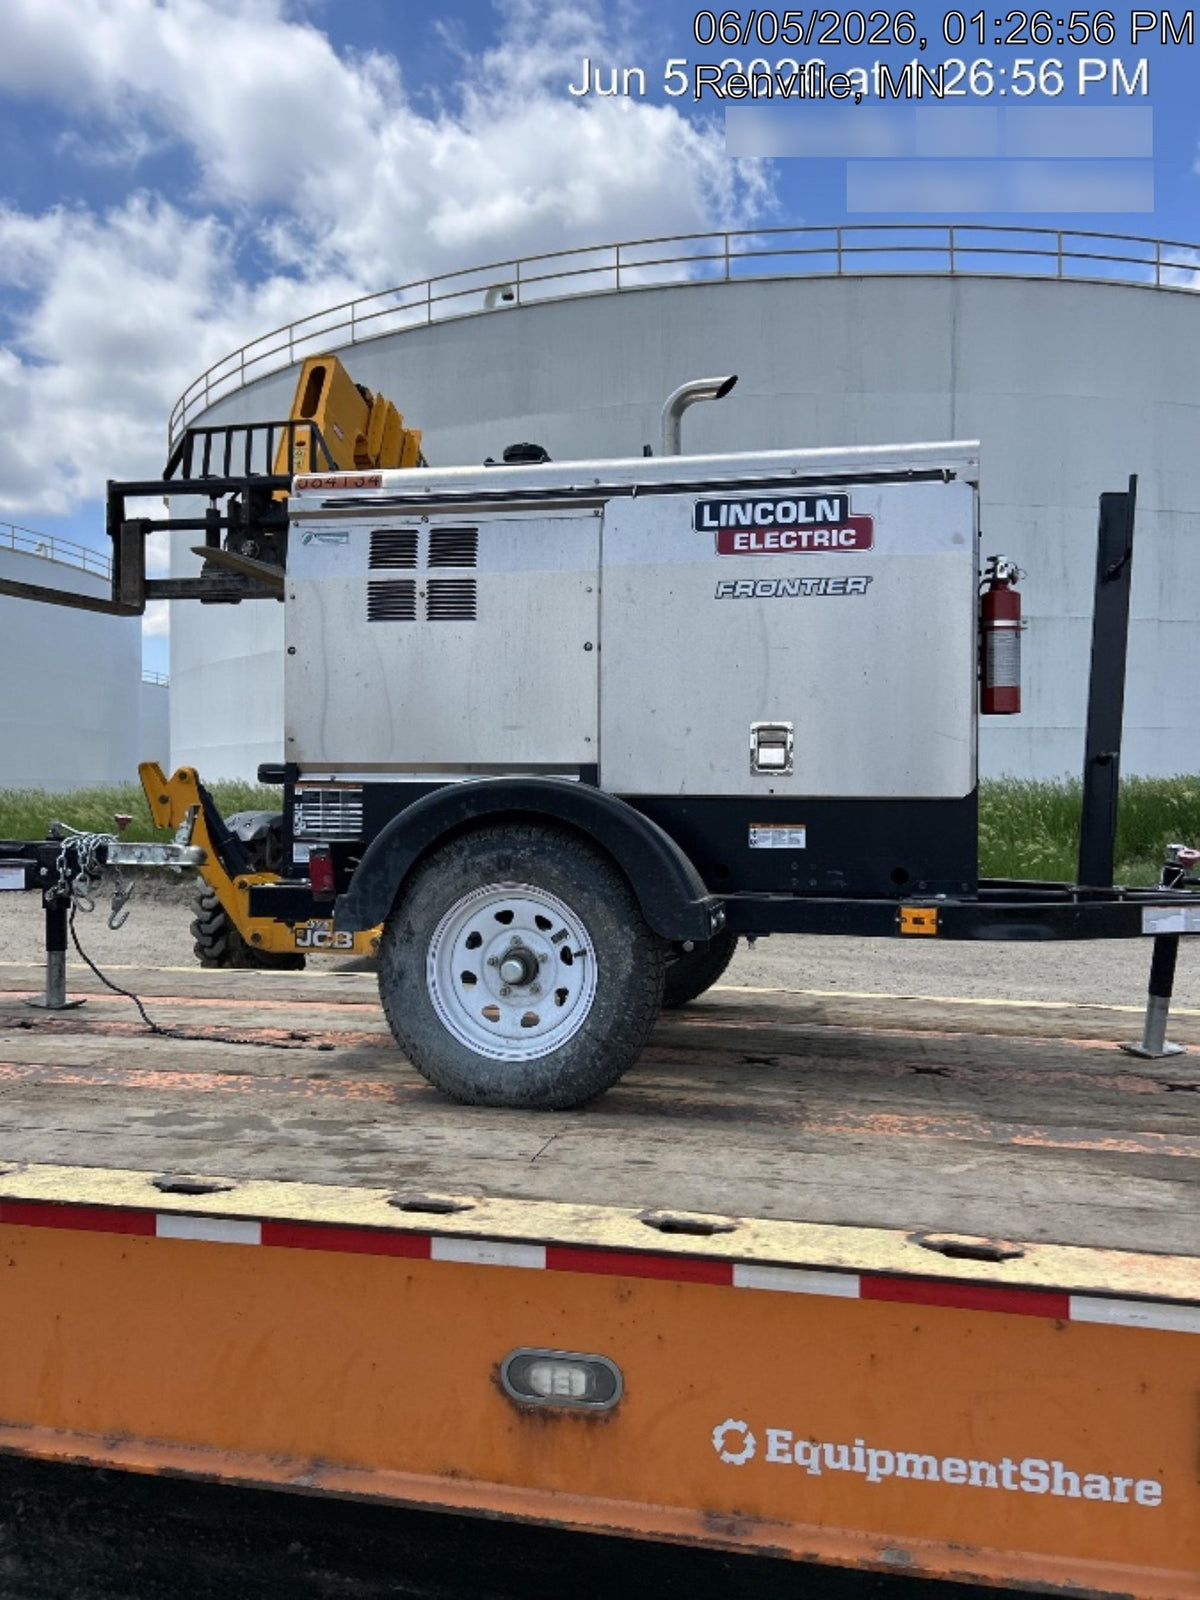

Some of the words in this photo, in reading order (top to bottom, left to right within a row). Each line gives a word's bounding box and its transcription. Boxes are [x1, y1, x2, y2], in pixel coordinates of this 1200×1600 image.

[703, 499, 840, 528] LINCOLN
[734, 529, 857, 551] ELECTRIC
[296, 929, 353, 949] JCB
[765, 1428, 1162, 1507] EquipmentShare
